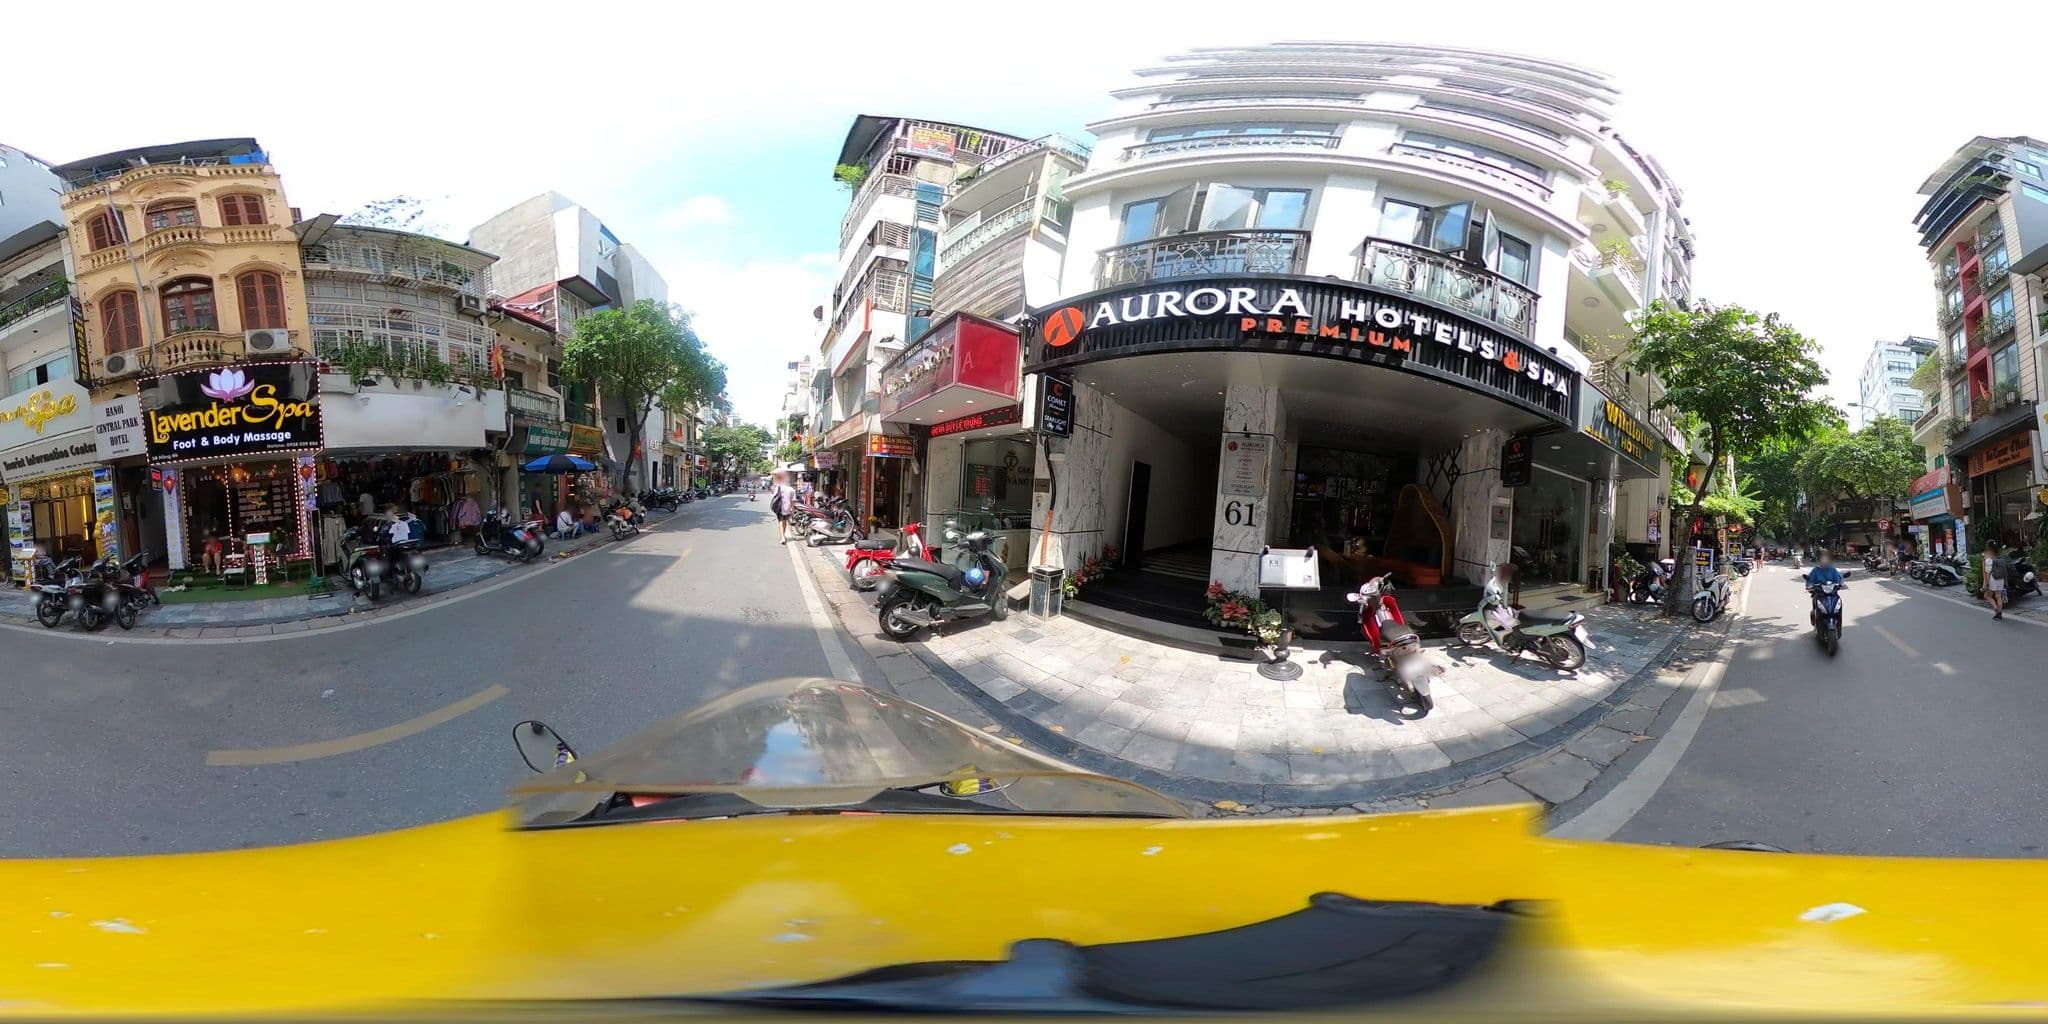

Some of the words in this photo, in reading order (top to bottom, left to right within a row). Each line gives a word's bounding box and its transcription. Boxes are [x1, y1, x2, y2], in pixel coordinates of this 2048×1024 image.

[1087, 287, 1313, 330] AURORA
[1240, 317, 1411, 353] PREMIUM
[1341, 299, 1495, 361] HOTELS
[1502, 350, 1521, 373] &
[1526, 360, 1569, 397] SPA
[105, 404, 124, 417] HANOI
[149, 402, 242, 444] Lavender
[242, 383, 315, 431] Spa
[96, 420, 122, 435] CENTRAL
[122, 416, 139, 429] PARK
[109, 434, 129, 446] HOTEL
[173, 438, 196, 451] Foot
[200, 436, 210, 447] &
[213, 433, 240, 448] Body
[243, 431, 292, 443] Massage
[3, 457, 26, 471] Tourist
[25, 447, 70, 466] Information
[69, 442, 97, 457] Center
[1225, 500, 1257, 528] 61
